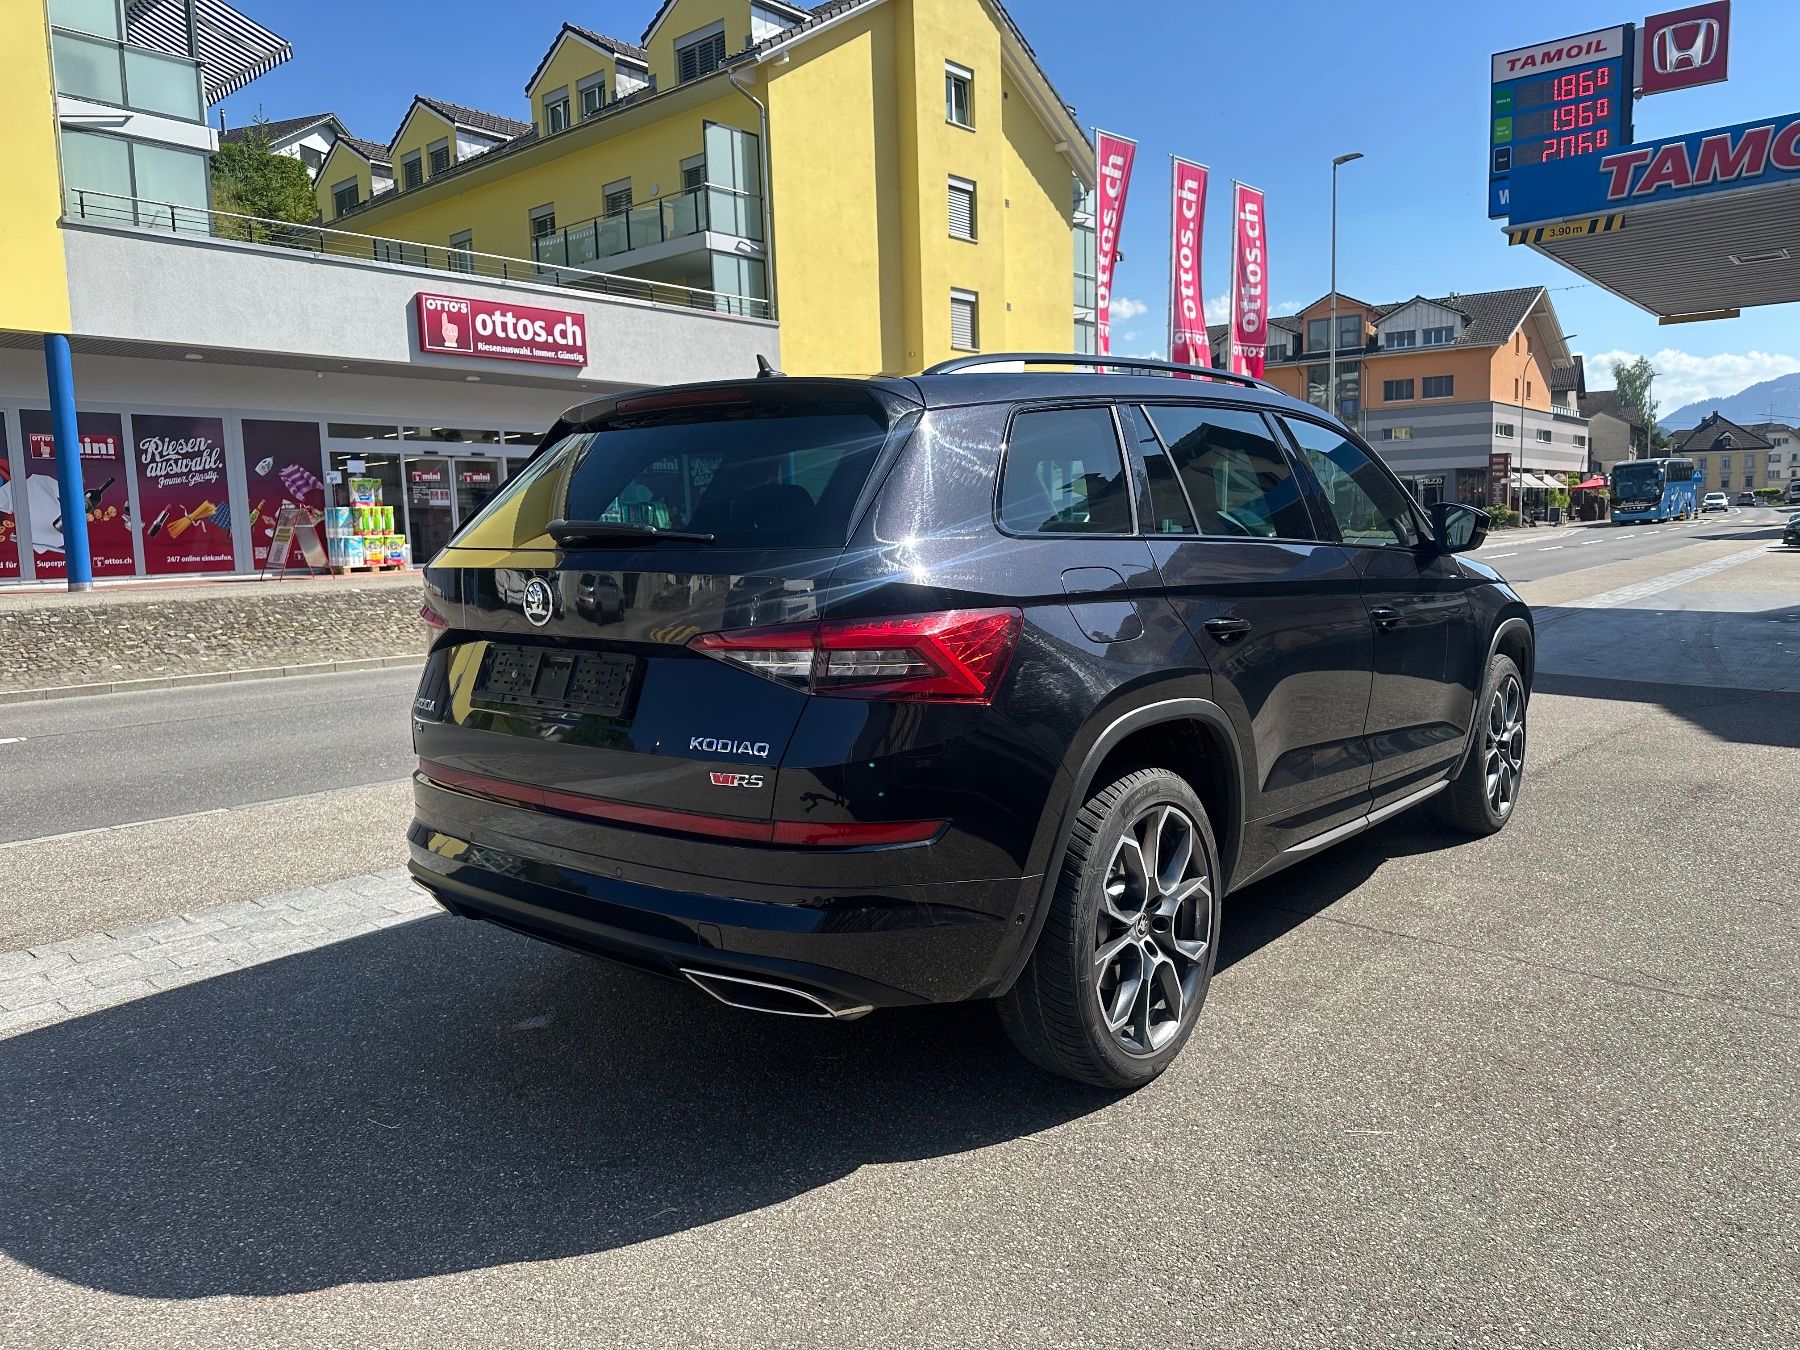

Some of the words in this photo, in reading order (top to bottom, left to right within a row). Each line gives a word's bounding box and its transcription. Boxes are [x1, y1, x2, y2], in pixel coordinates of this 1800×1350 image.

[1507, 40, 1607, 72] TAMOIL
[1549, 225, 1571, 237] 3.90
[1573, 225, 1583, 233] m
[1178, 179, 1199, 319] ottos.ch
[1240, 202, 1262, 333] ottos.ch
[426, 299, 468, 314] OTTO'S
[475, 310, 583, 346] ottos.ch
[477, 342, 532, 356] Riesenauswahl.
[1233, 345, 1265, 358] OTTO'S
[140, 437, 212, 463] Riesen-
[147, 448, 223, 477] auswahl.
[422, 472, 441, 480] mini
[104, 557, 132, 565] ottos.ch
[689, 737, 769, 758] KODIAQ
